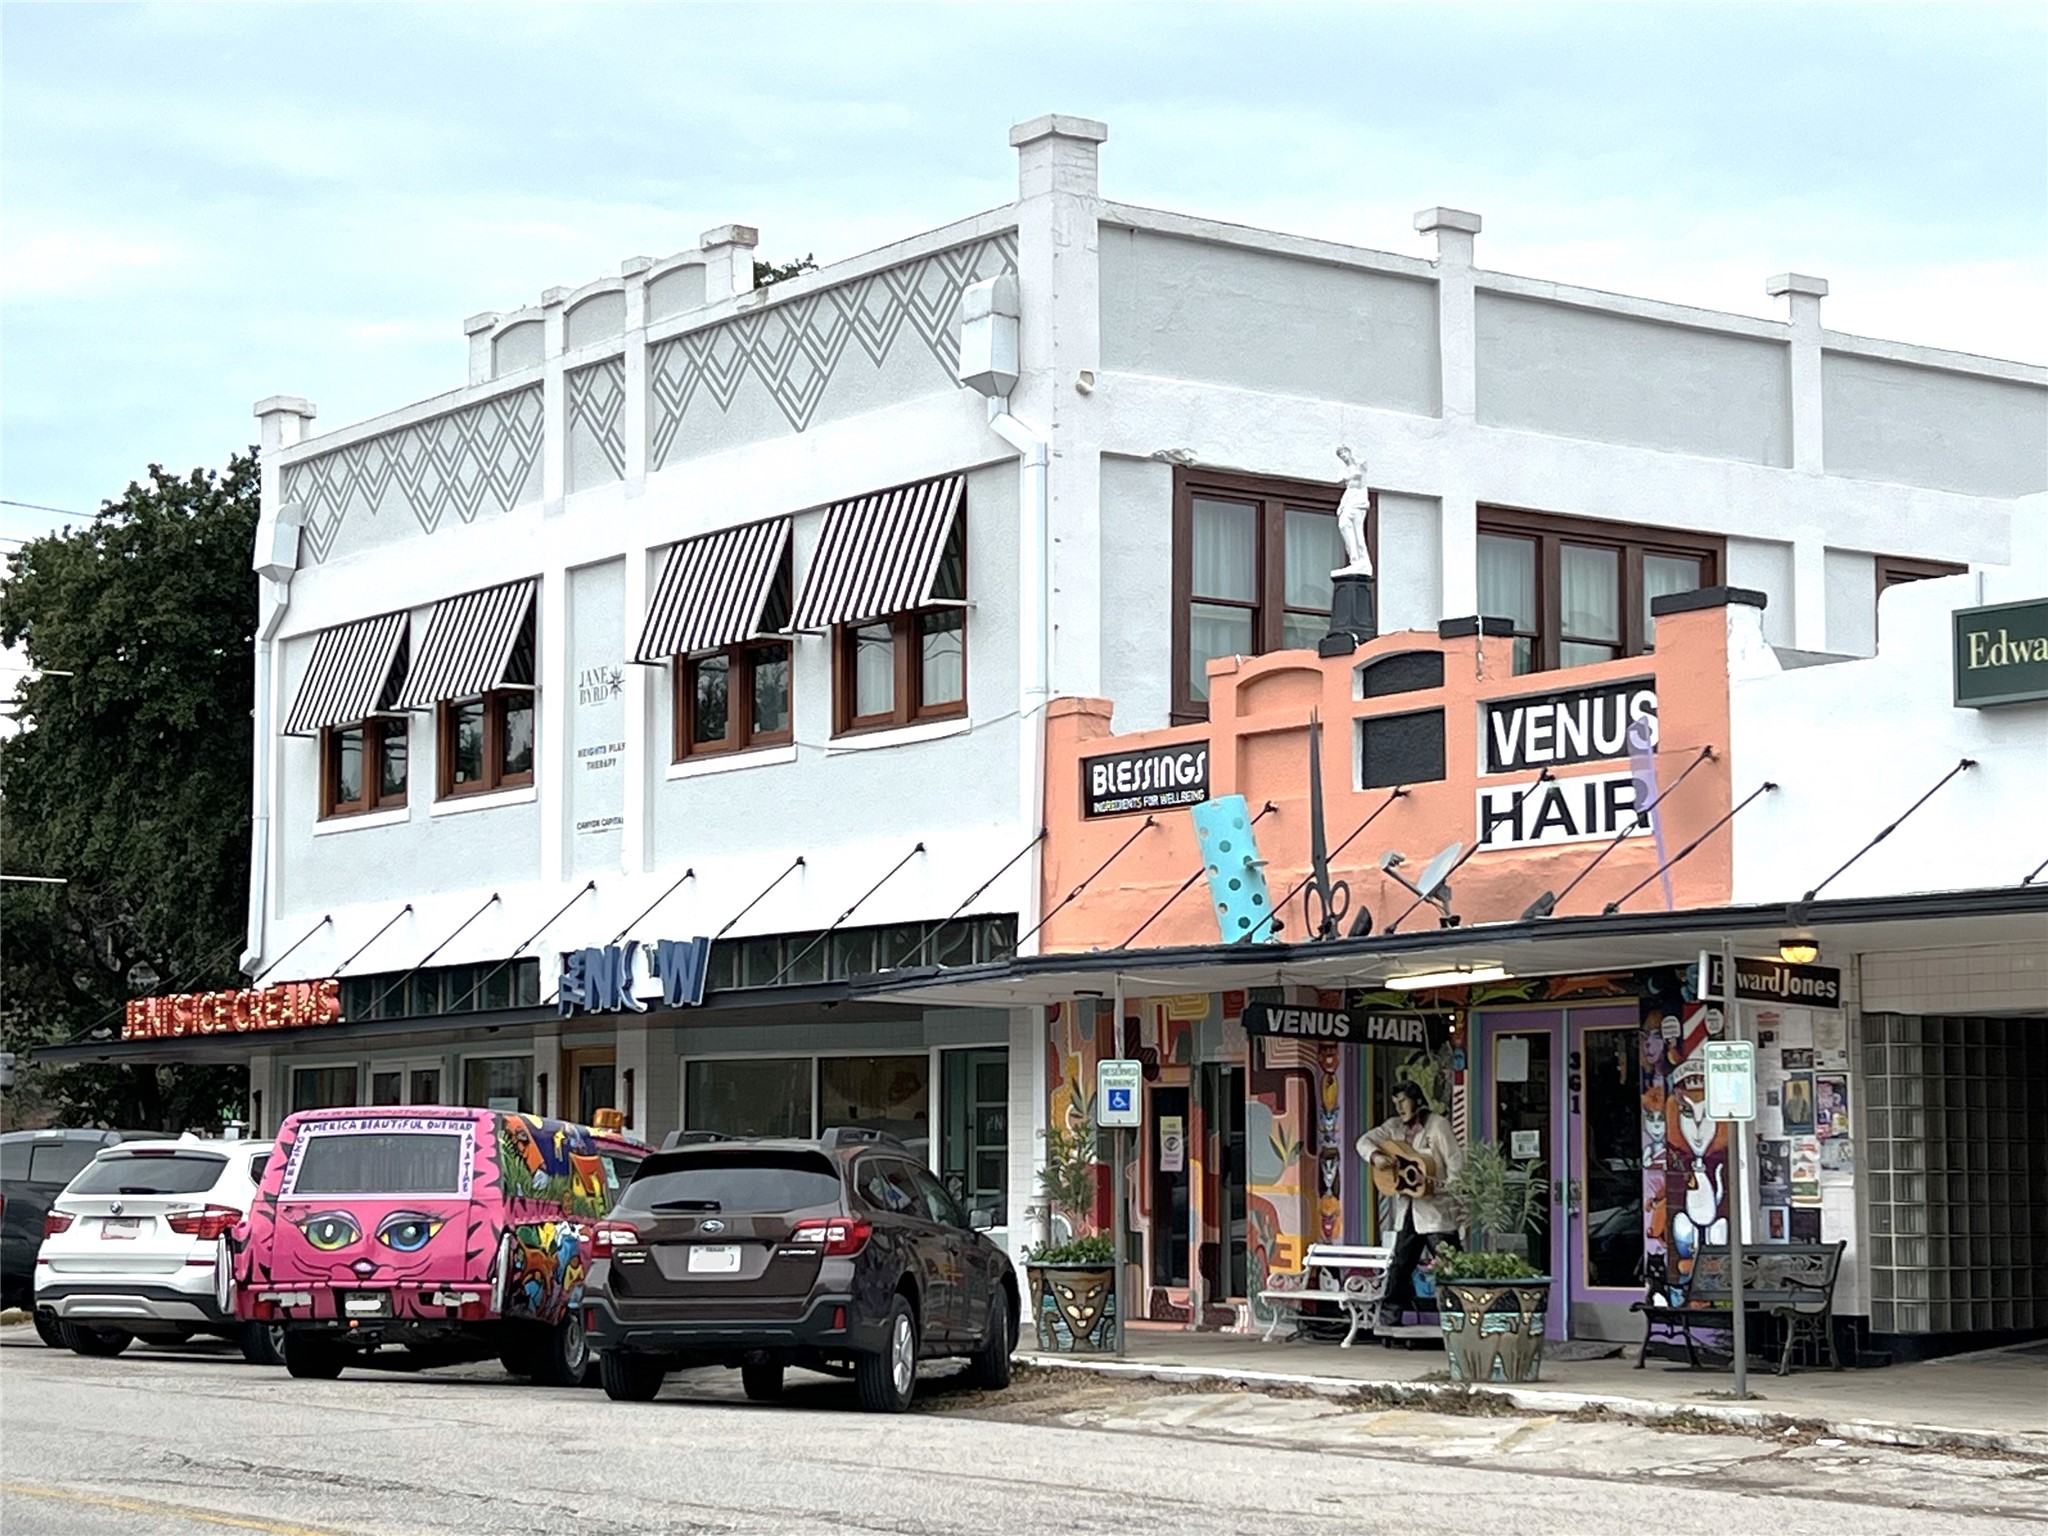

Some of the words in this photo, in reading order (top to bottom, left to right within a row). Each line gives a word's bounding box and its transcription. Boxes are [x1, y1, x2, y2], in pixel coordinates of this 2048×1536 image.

[579, 666, 609, 688] JANE
[579, 684, 609, 705] BYRD
[1491, 689, 1659, 766] VENUS
[1092, 751, 1206, 796] BLESSINGS
[1143, 794, 1159, 807] FOR
[1481, 777, 1651, 844] HAIR
[1711, 960, 1781, 993] Eward
[232, 979, 342, 1032] CREAMS
[1266, 1008, 1350, 1037] VENUS
[1366, 1016, 1424, 1043] HAIR
[1711, 1062, 1749, 1074] PARKING
[303, 1121, 357, 1133] AMERICA
